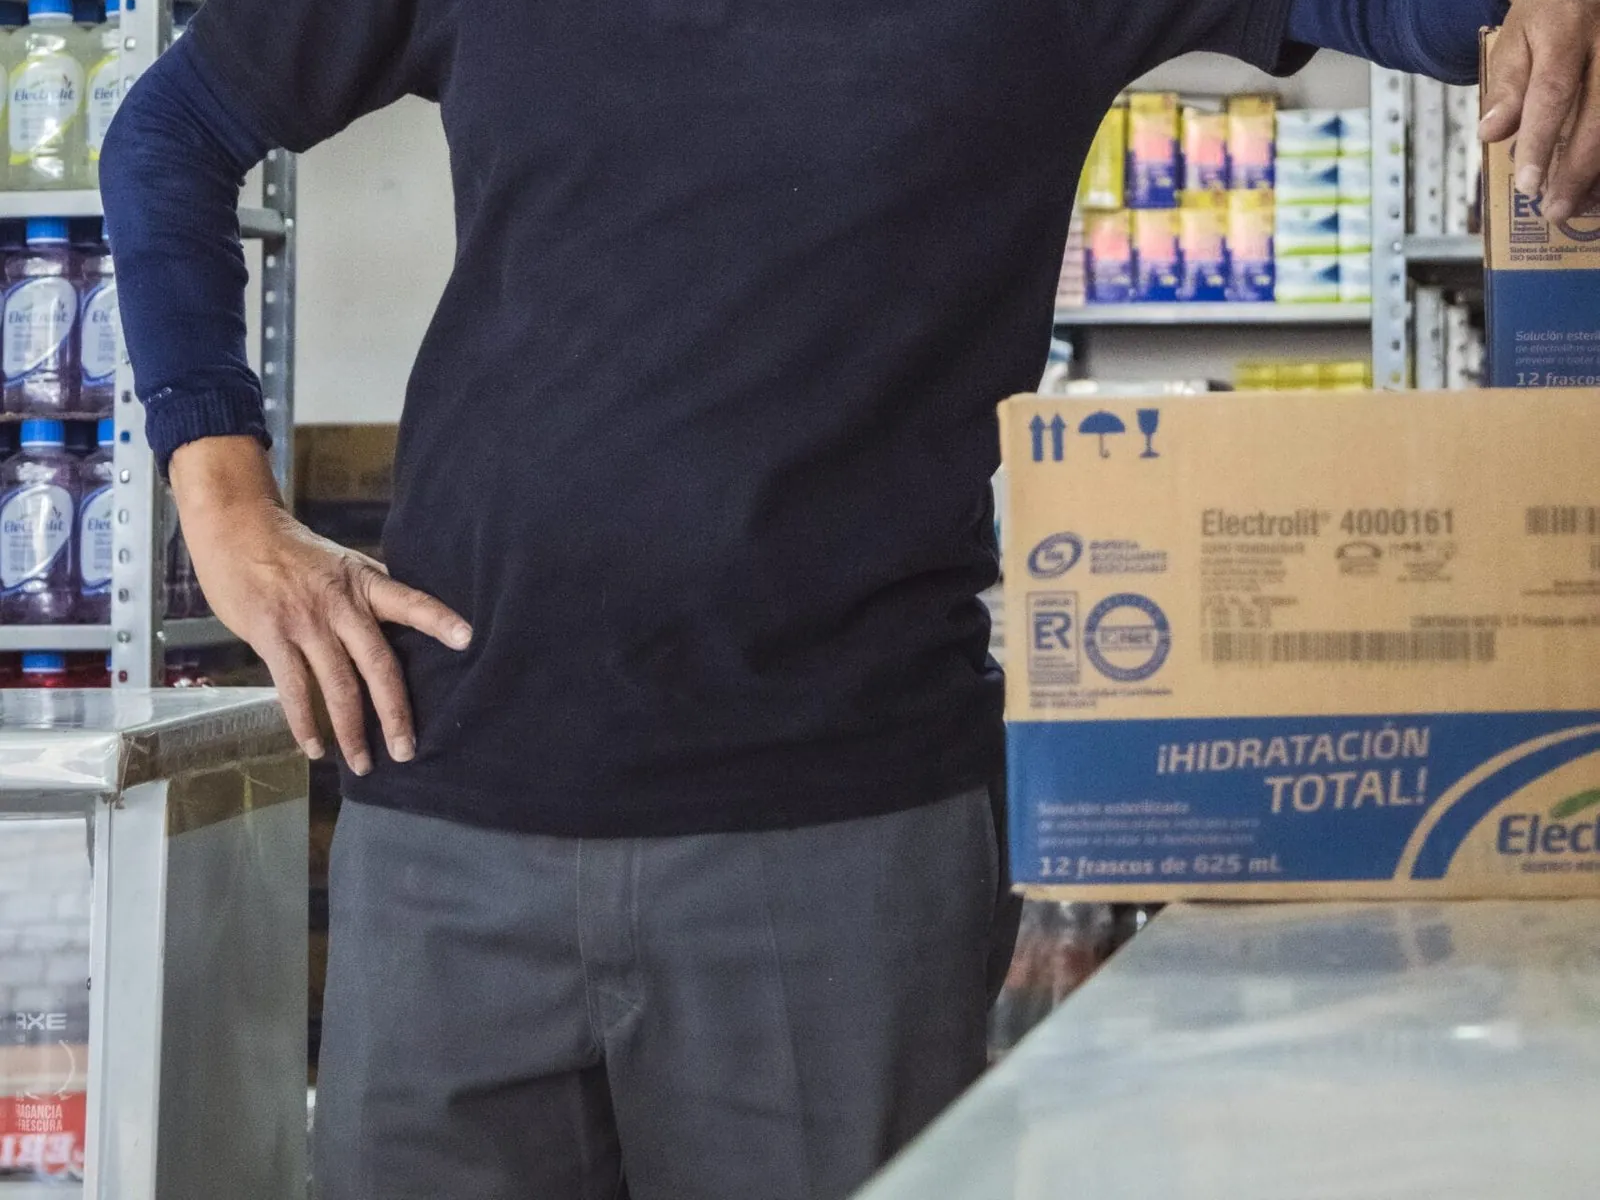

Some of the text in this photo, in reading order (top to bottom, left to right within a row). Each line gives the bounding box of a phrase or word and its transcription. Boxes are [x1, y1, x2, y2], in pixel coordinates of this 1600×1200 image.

[1515, 372, 1540, 386] 12
[1339, 508, 1455, 536] 4000161
[1034, 612, 1072, 650] ER
[1264, 766, 1428, 814] TOTAL!
[1039, 855, 1072, 877] 12
[1074, 855, 1154, 880] frascos
[1160, 856, 1187, 875] de
[1194, 853, 1243, 874] 625
